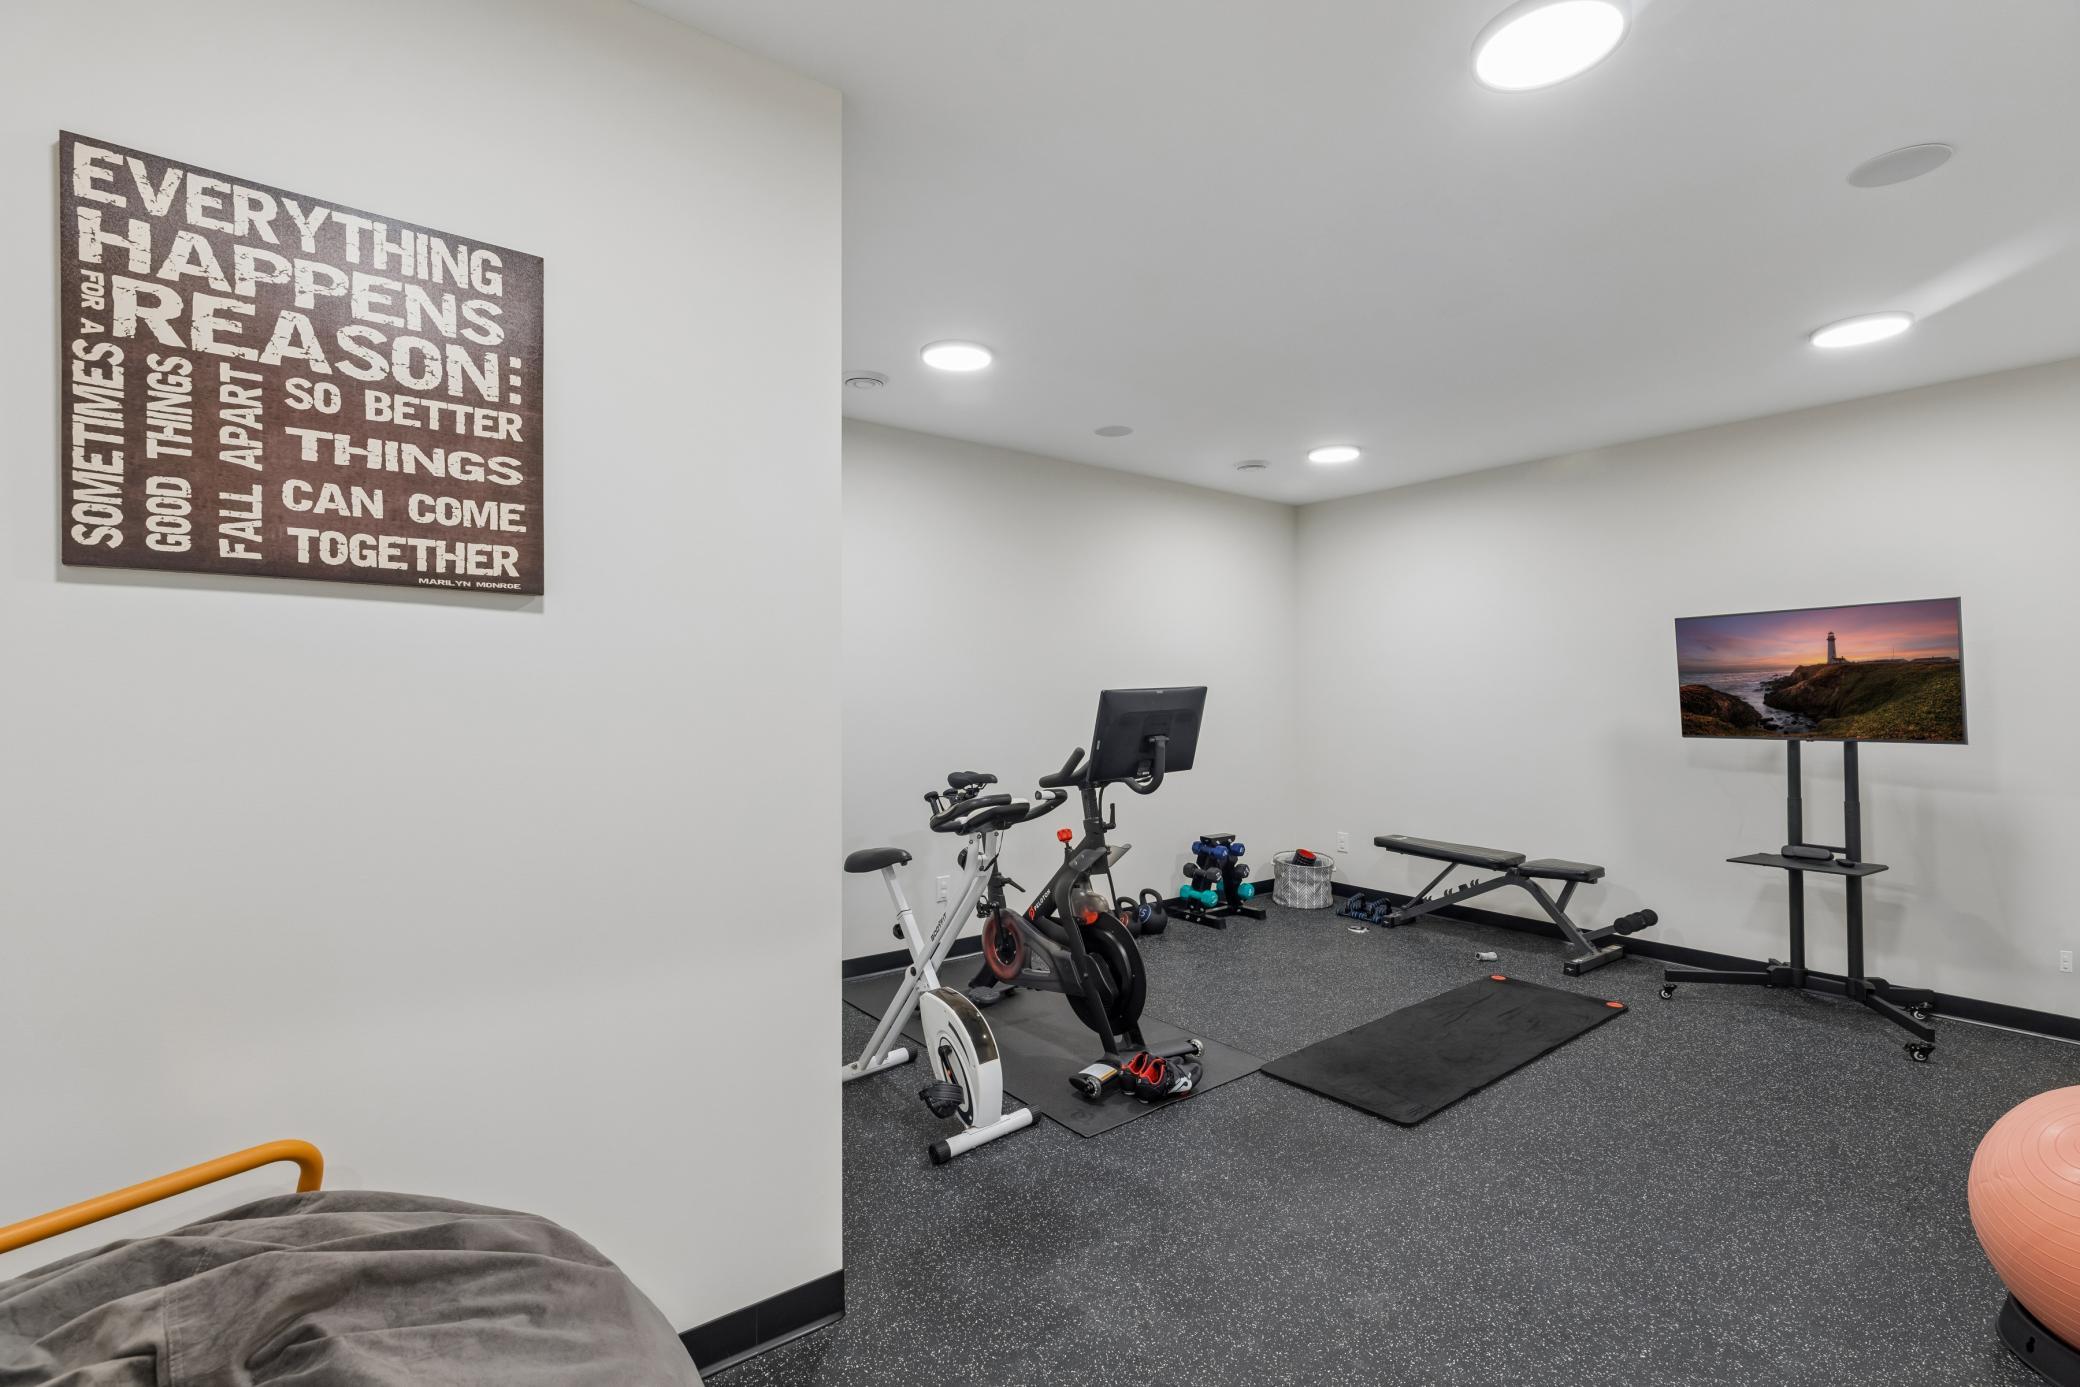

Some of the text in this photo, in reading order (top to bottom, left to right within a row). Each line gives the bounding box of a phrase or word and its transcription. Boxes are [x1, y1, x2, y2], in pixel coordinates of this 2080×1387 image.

[73, 141, 503, 298] EVERYTHING
[77, 206, 505, 347] HAPPENS
[81, 269, 105, 334] FOR A
[285, 377, 524, 443] SO BETTER
[71, 338, 125, 549] SOMETIMES
[146, 353, 193, 553] GOOD THINGS
[219, 362, 264, 560] FALL APART
[285, 426, 524, 487] THINGS
[282, 478, 527, 533] CAN COME
[286, 527, 520, 578] TOGETHER
[418, 578, 521, 590] MARILYN MONROE
